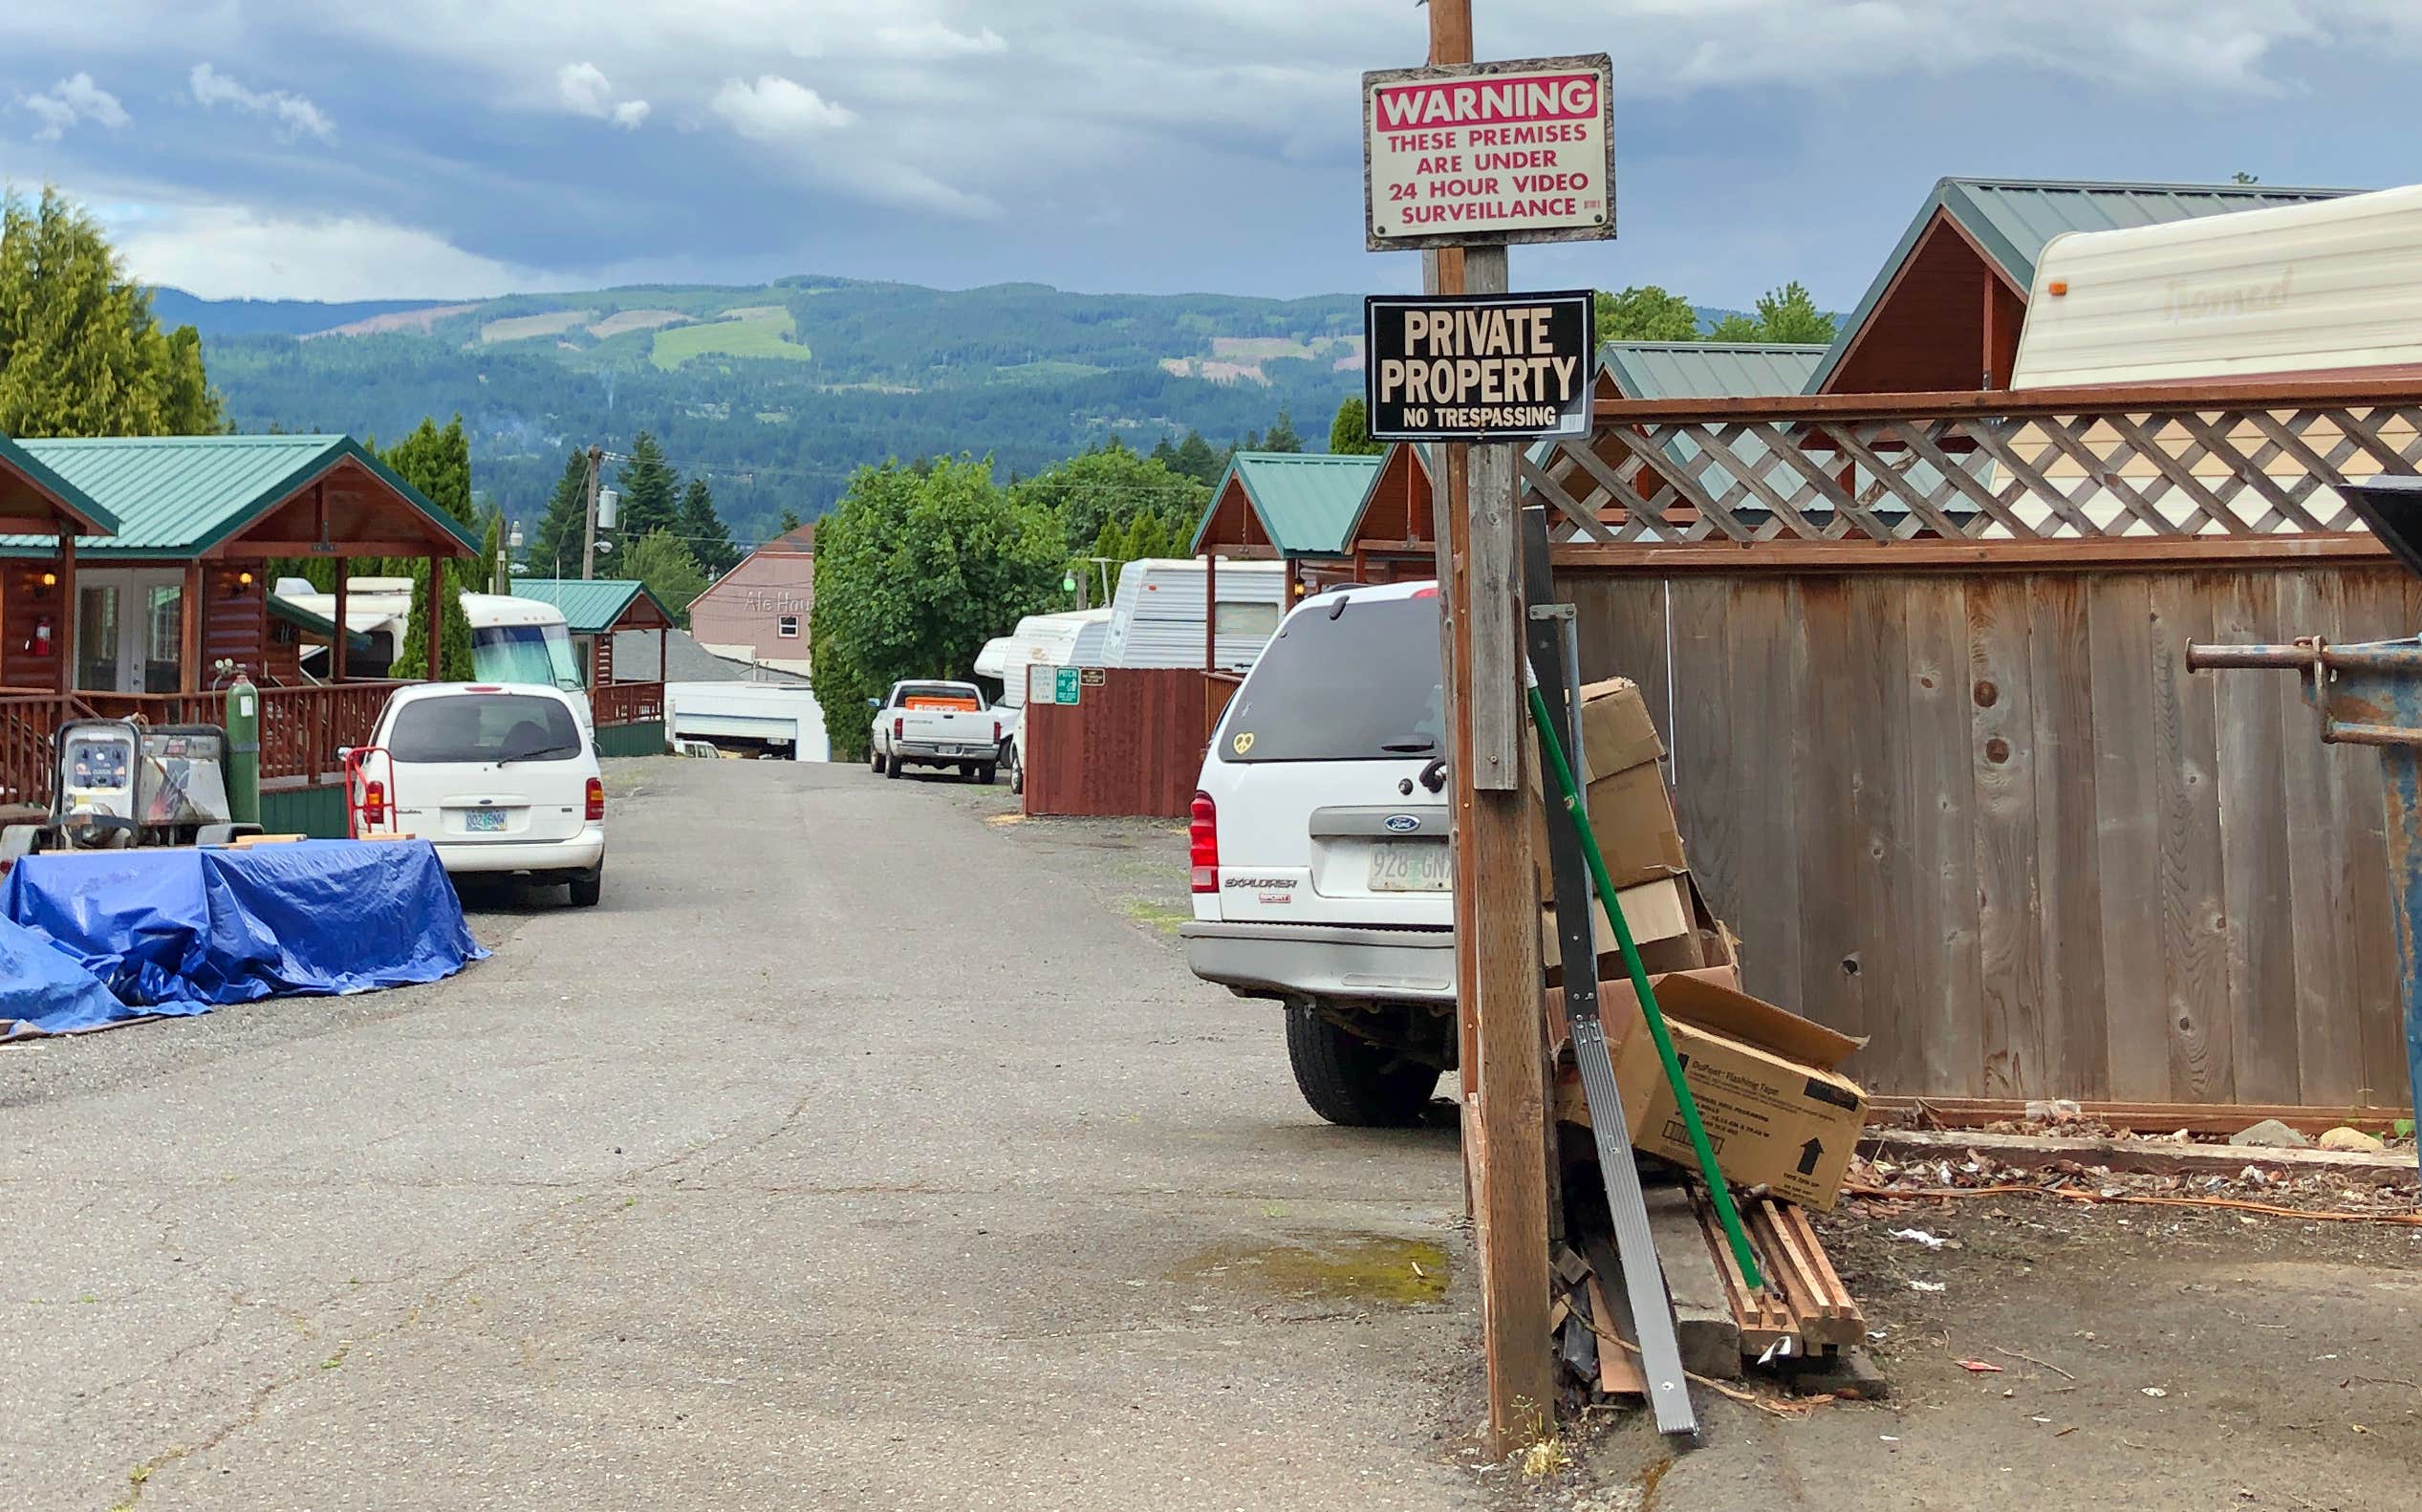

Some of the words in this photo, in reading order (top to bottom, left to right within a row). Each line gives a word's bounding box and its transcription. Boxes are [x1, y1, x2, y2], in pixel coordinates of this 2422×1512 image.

[1382, 80, 1594, 126] WARNING
[1389, 131, 1457, 153] THESE
[1469, 124, 1587, 148] PREMISES
[1416, 156, 1462, 175] ARE
[1475, 150, 1557, 172] UNDER
[1389, 183, 1417, 201] 24
[1430, 179, 1499, 199] HOUR
[1512, 172, 1589, 193] VIDEO
[1401, 198, 1576, 225] SURVEILLANCE
[1404, 308, 1553, 356] PRIVATE
[1381, 356, 1577, 403] PROPERTY
[1403, 408, 1428, 428] NO
[1435, 405, 1556, 428] TRESPASSING
[745, 591, 772, 613] Ale
[778, 591, 811, 614] Hou
[1374, 849, 1408, 878] 928
[1224, 877, 1299, 889] EXPLORER
